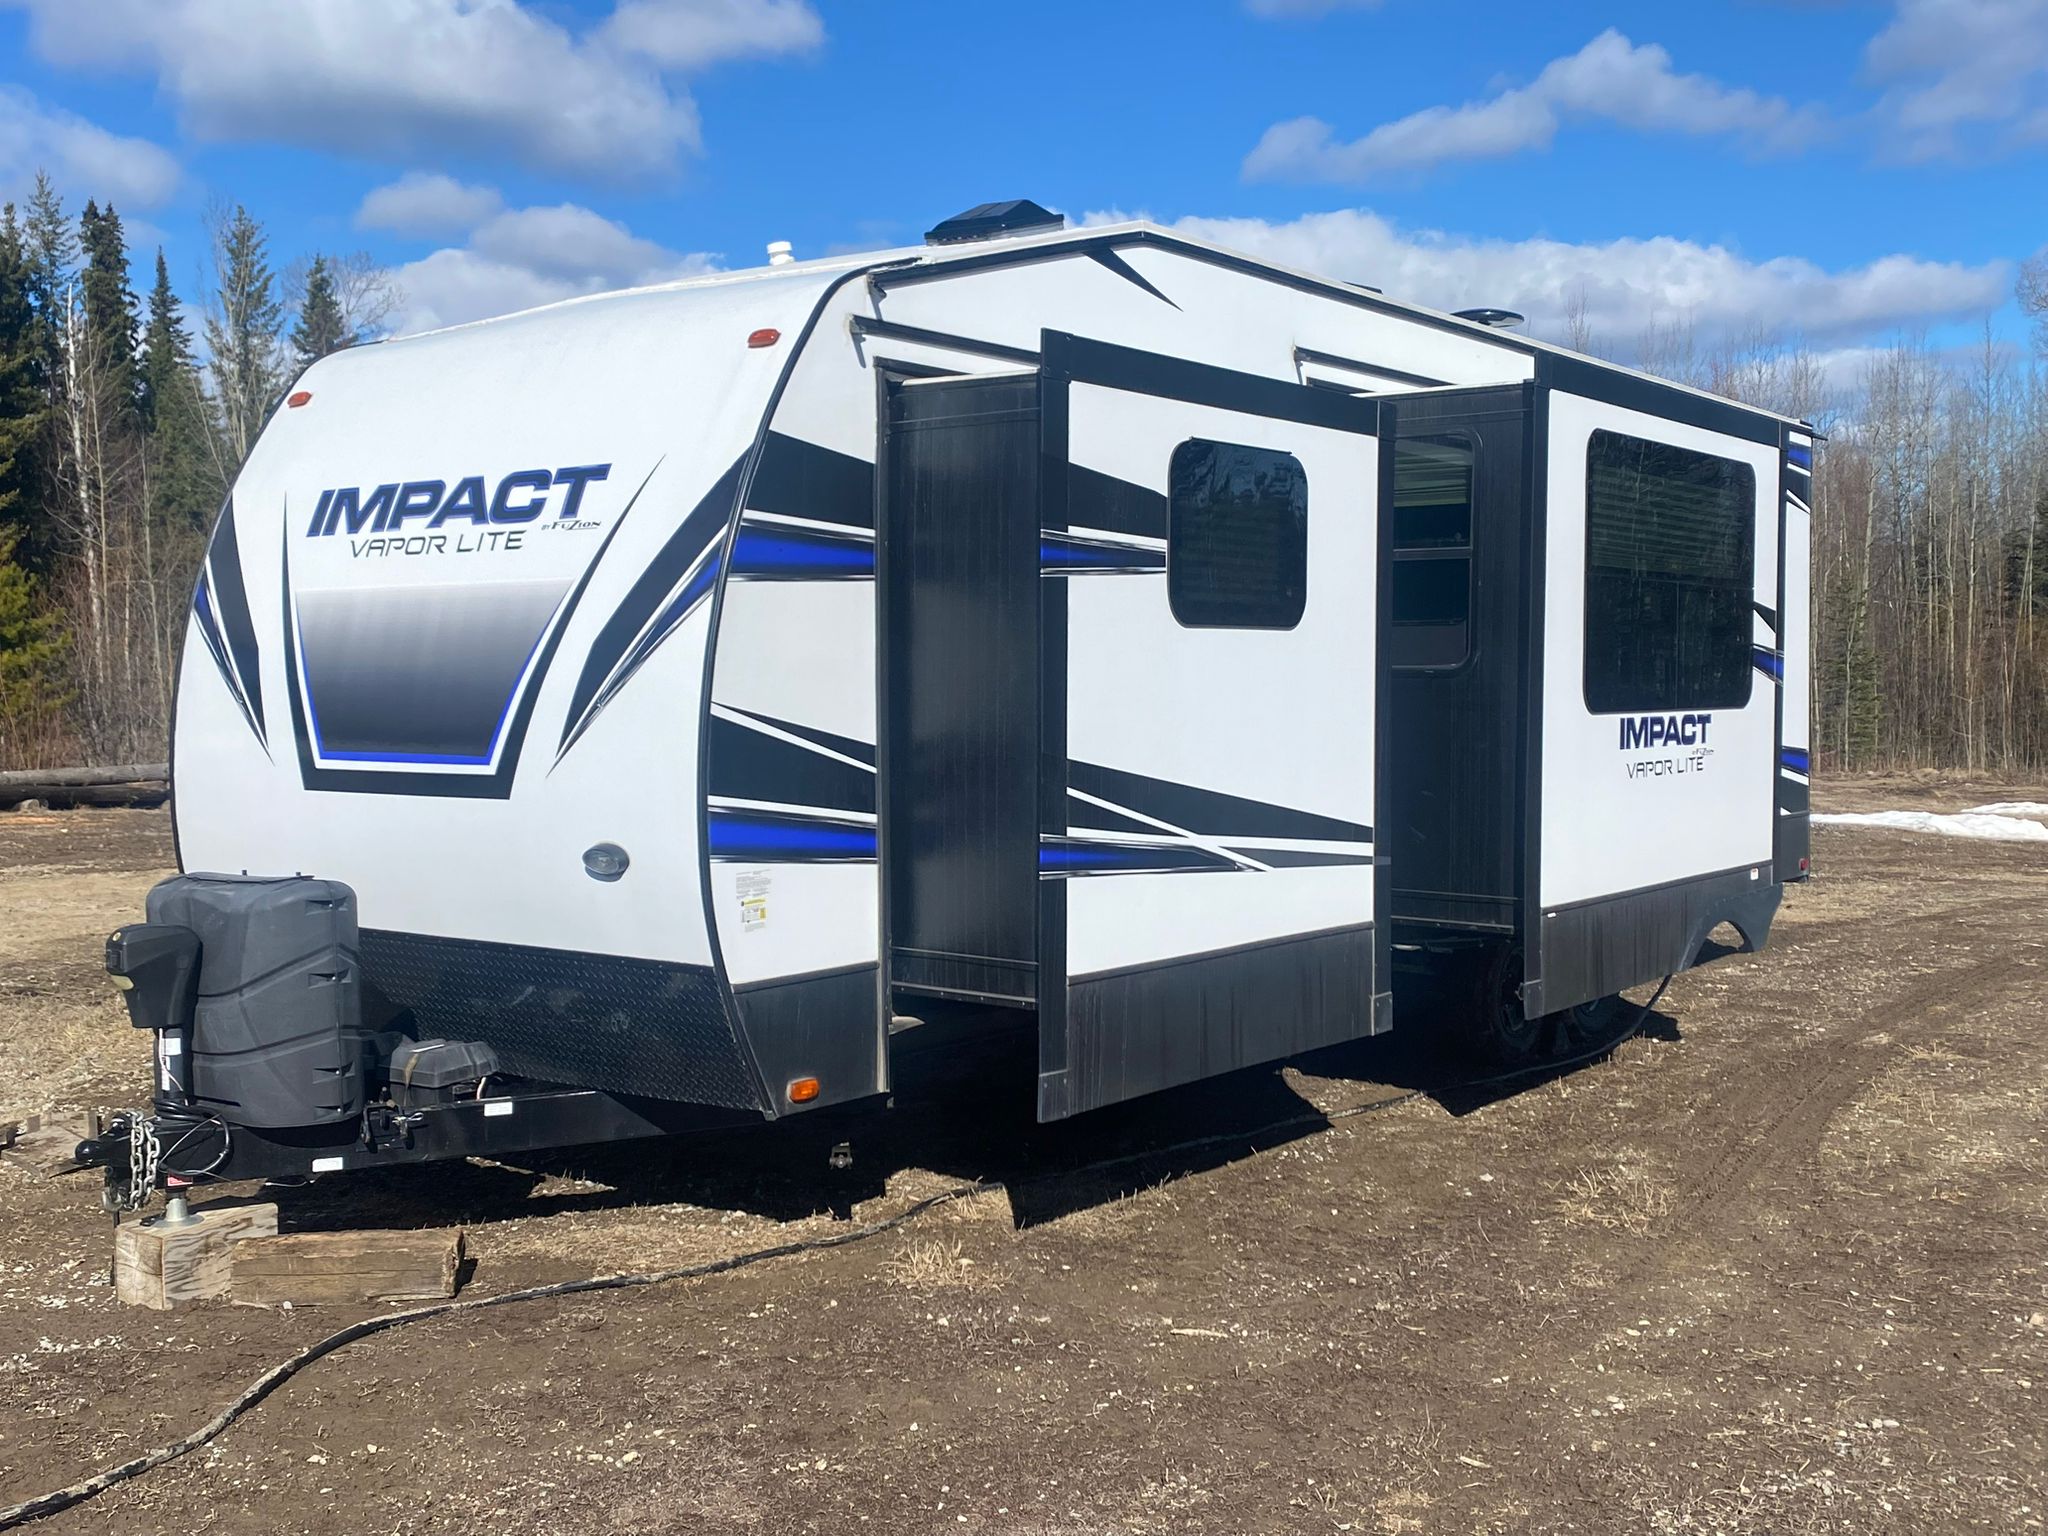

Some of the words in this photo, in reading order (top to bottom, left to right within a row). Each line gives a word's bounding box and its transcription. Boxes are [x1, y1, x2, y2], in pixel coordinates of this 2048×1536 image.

[306, 463, 612, 537] IMPACT
[350, 535, 446, 558] VAPOR
[456, 530, 527, 553] LITE
[1620, 714, 1711, 750] IMPACT
[1626, 759, 1673, 779] VAPOR
[1677, 756, 1704, 773] LITE
